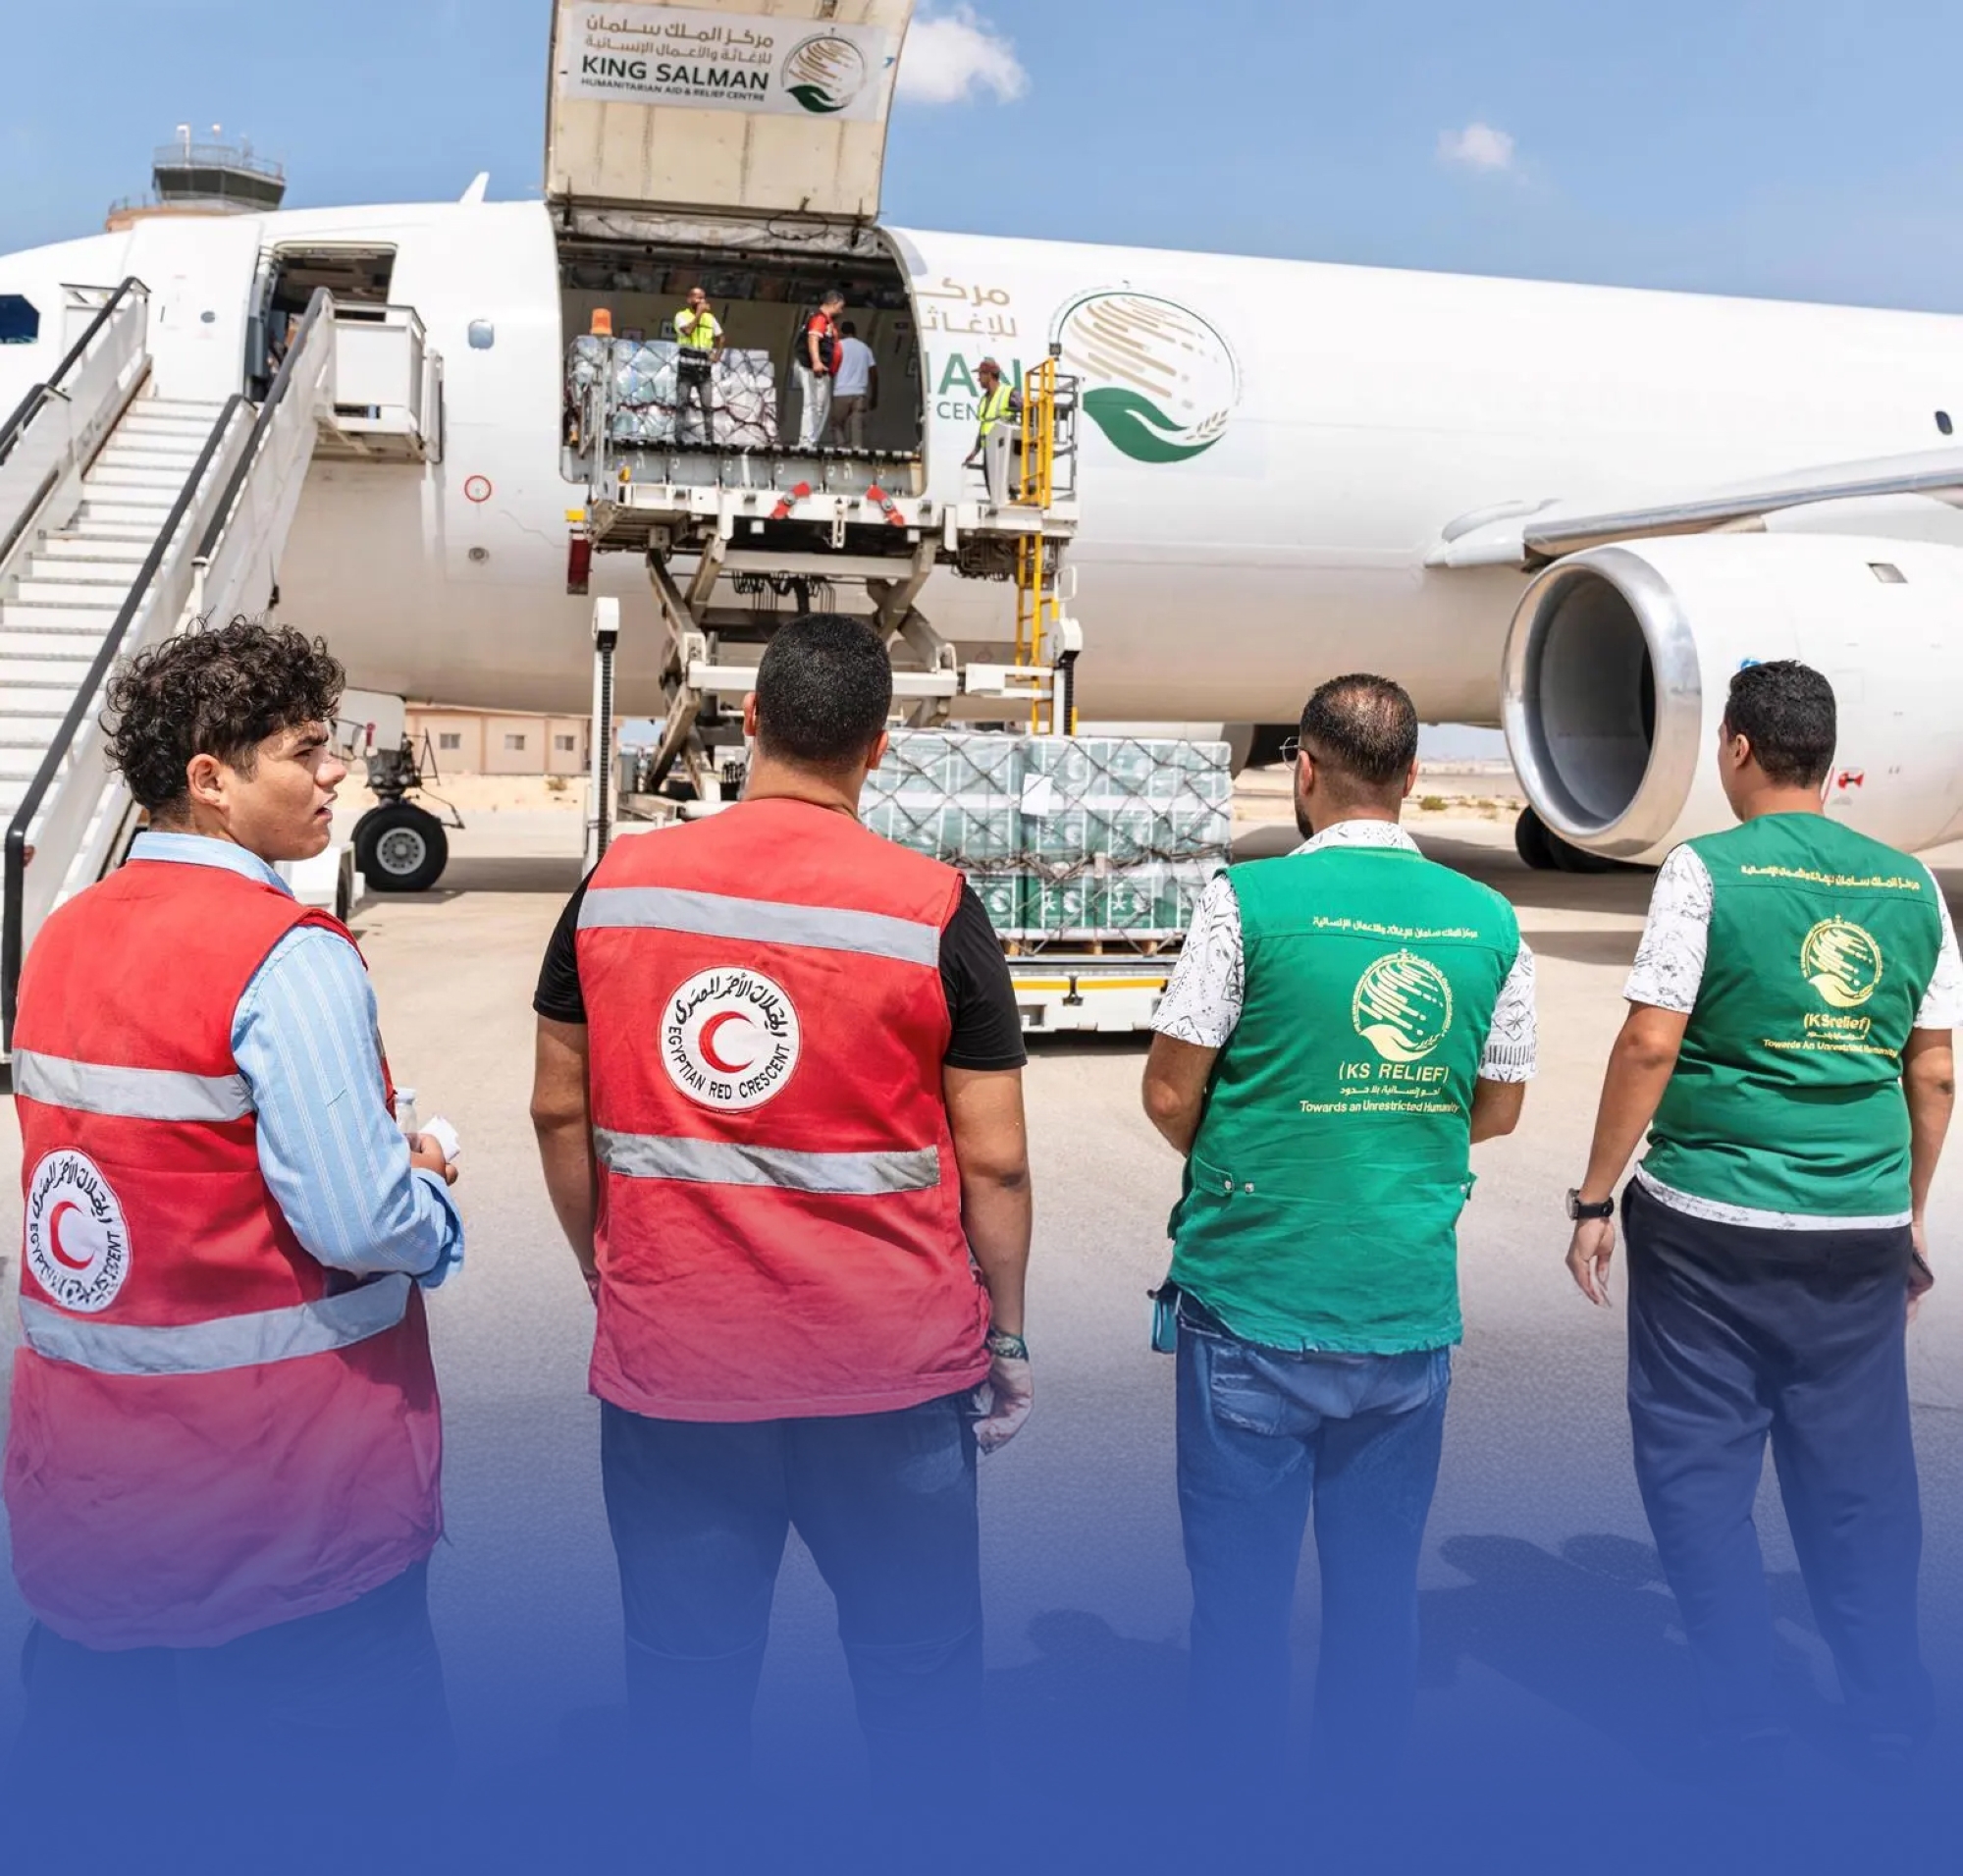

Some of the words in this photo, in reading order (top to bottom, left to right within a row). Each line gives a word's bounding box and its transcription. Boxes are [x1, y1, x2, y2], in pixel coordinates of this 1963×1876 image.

[586, 13, 662, 35] سلمان
[664, 22, 722, 42] الملك
[724, 27, 774, 49] مركز
[582, 54, 648, 80] KING
[656, 63, 769, 91] SALMAN
[581, 78, 663, 93] HUMANITARIAN
[664, 85, 683, 95] AID
[693, 86, 726, 99] RELIEF
[726, 90, 766, 102] CENTRE
[915, 276, 1011, 308] مرك
[668, 1026, 707, 1092] EGYPTIAN
[709, 1081, 732, 1100] RED
[738, 1043, 791, 1099] CRESCENT
[1339, 1060, 1371, 1081] (KS
[1378, 1063, 1450, 1084] RELIEF)
[1300, 1099, 1347, 1113] Towards
[1349, 1102, 1361, 1112] an
[1362, 1099, 1423, 1112] Unrestricted
